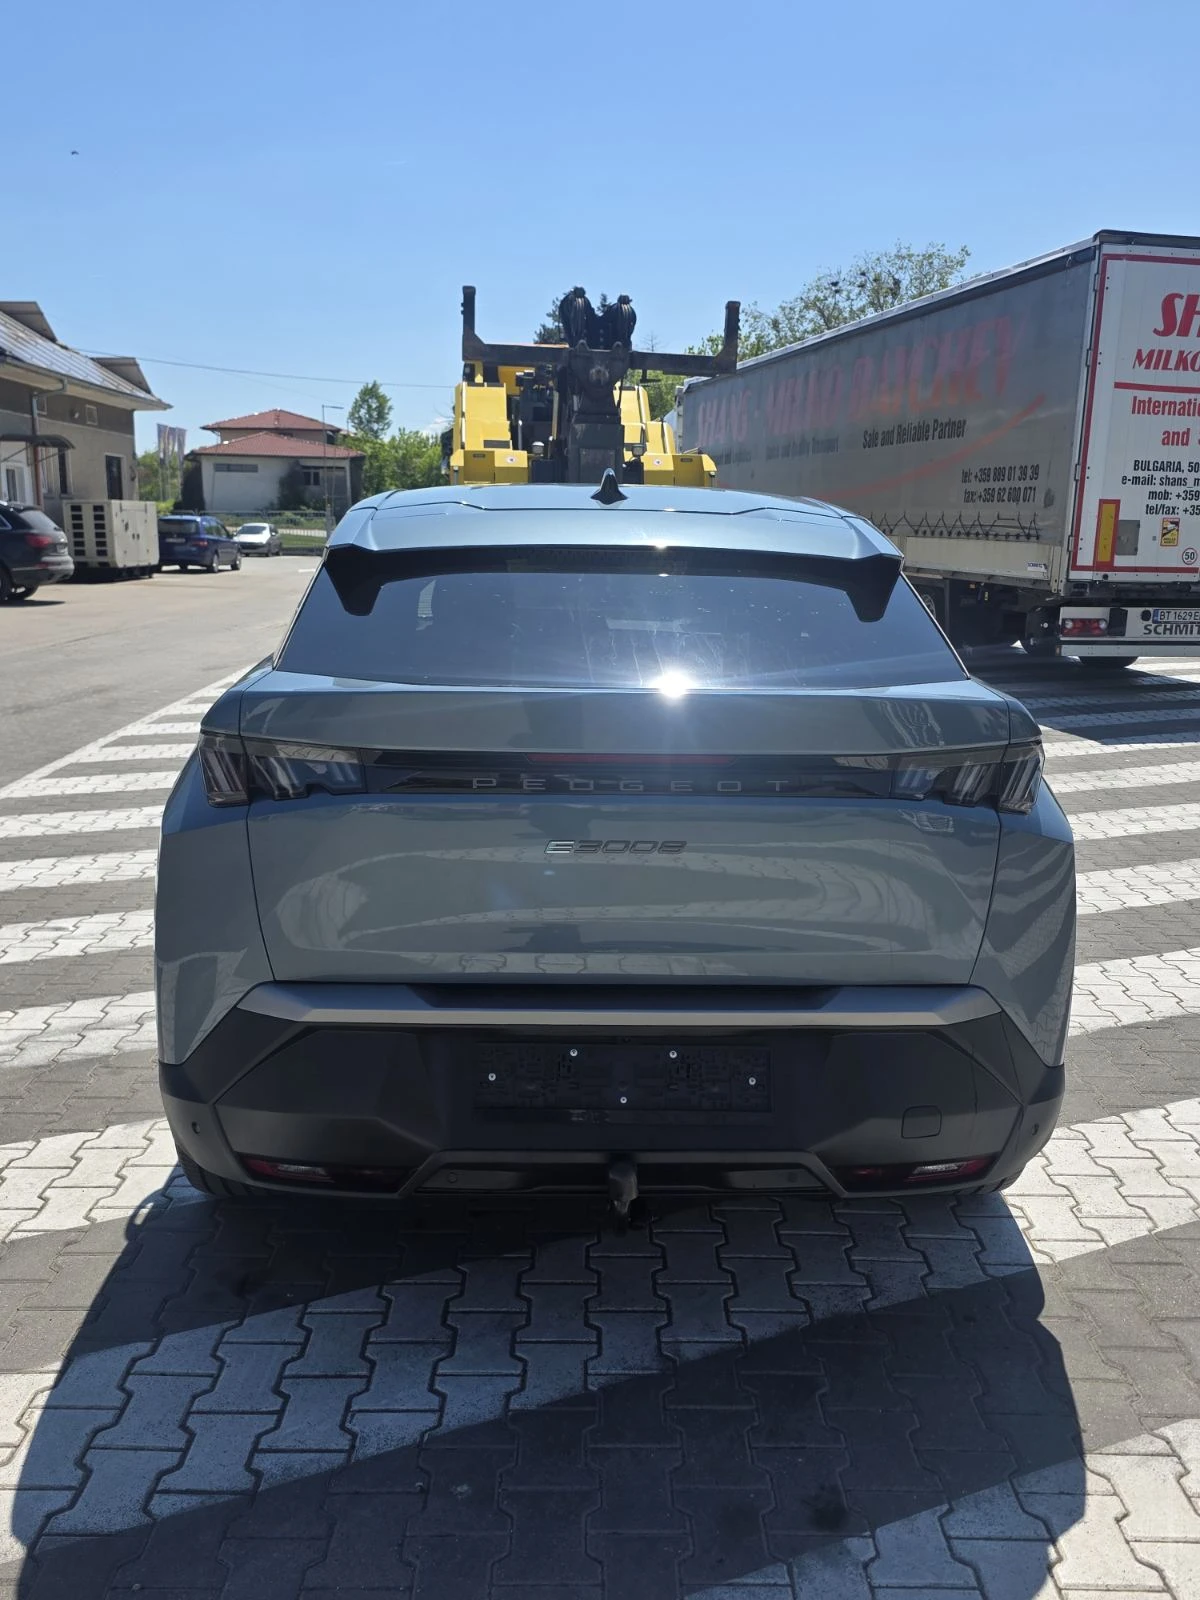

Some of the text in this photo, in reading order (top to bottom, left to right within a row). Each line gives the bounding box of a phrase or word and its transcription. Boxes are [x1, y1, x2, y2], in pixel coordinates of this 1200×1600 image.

[880, 426, 895, 447] and
[896, 420, 930, 445] Reliable
[931, 417, 967, 441] Partner
[1161, 427, 1191, 447] and
[974, 466, 991, 483] +359
[1029, 463, 1040, 480] 39
[1133, 459, 1185, 474] BULGARIA,
[1121, 474, 1157, 486] e-mail:
[977, 487, 996, 503] +359
[996, 487, 1007, 503] 62
[1022, 485, 1037, 502] 071
[1148, 489, 1200, 501] mob: +359
[1145, 503, 1180, 516] tel/fax:
[1184, 551, 1195, 561] 50
[1159, 610, 1171, 621] BT
[1174, 610, 1193, 621] 1629
[472, 777, 789, 793] PEUGEOT
